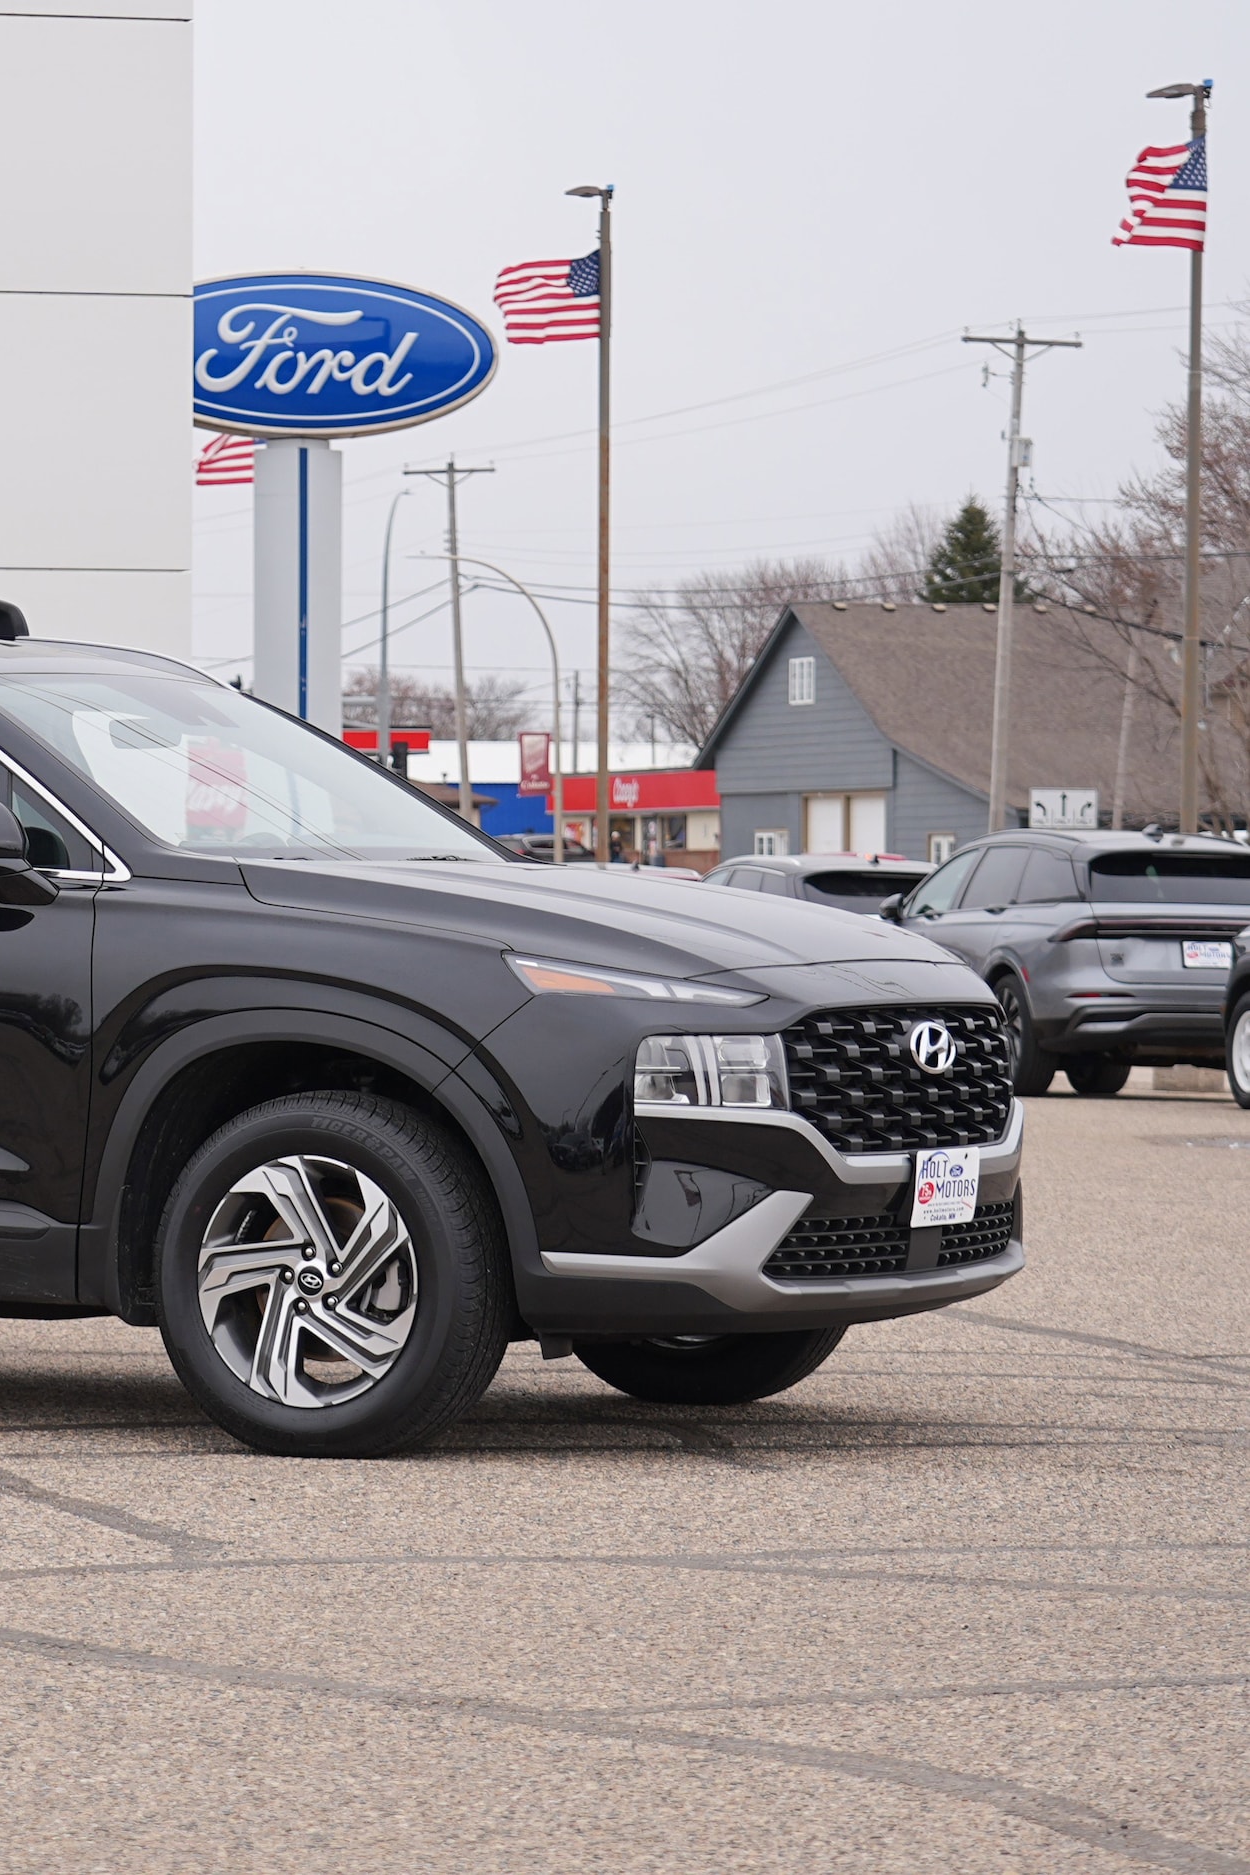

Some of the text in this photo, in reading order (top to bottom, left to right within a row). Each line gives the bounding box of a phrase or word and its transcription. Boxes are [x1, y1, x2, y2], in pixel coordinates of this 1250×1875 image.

[194, 302, 419, 396] Ford
[311, 1117, 417, 1181] TIGER PAW
[921, 1159, 948, 1179] HOLT
[935, 1179, 975, 1199] MOTORS
